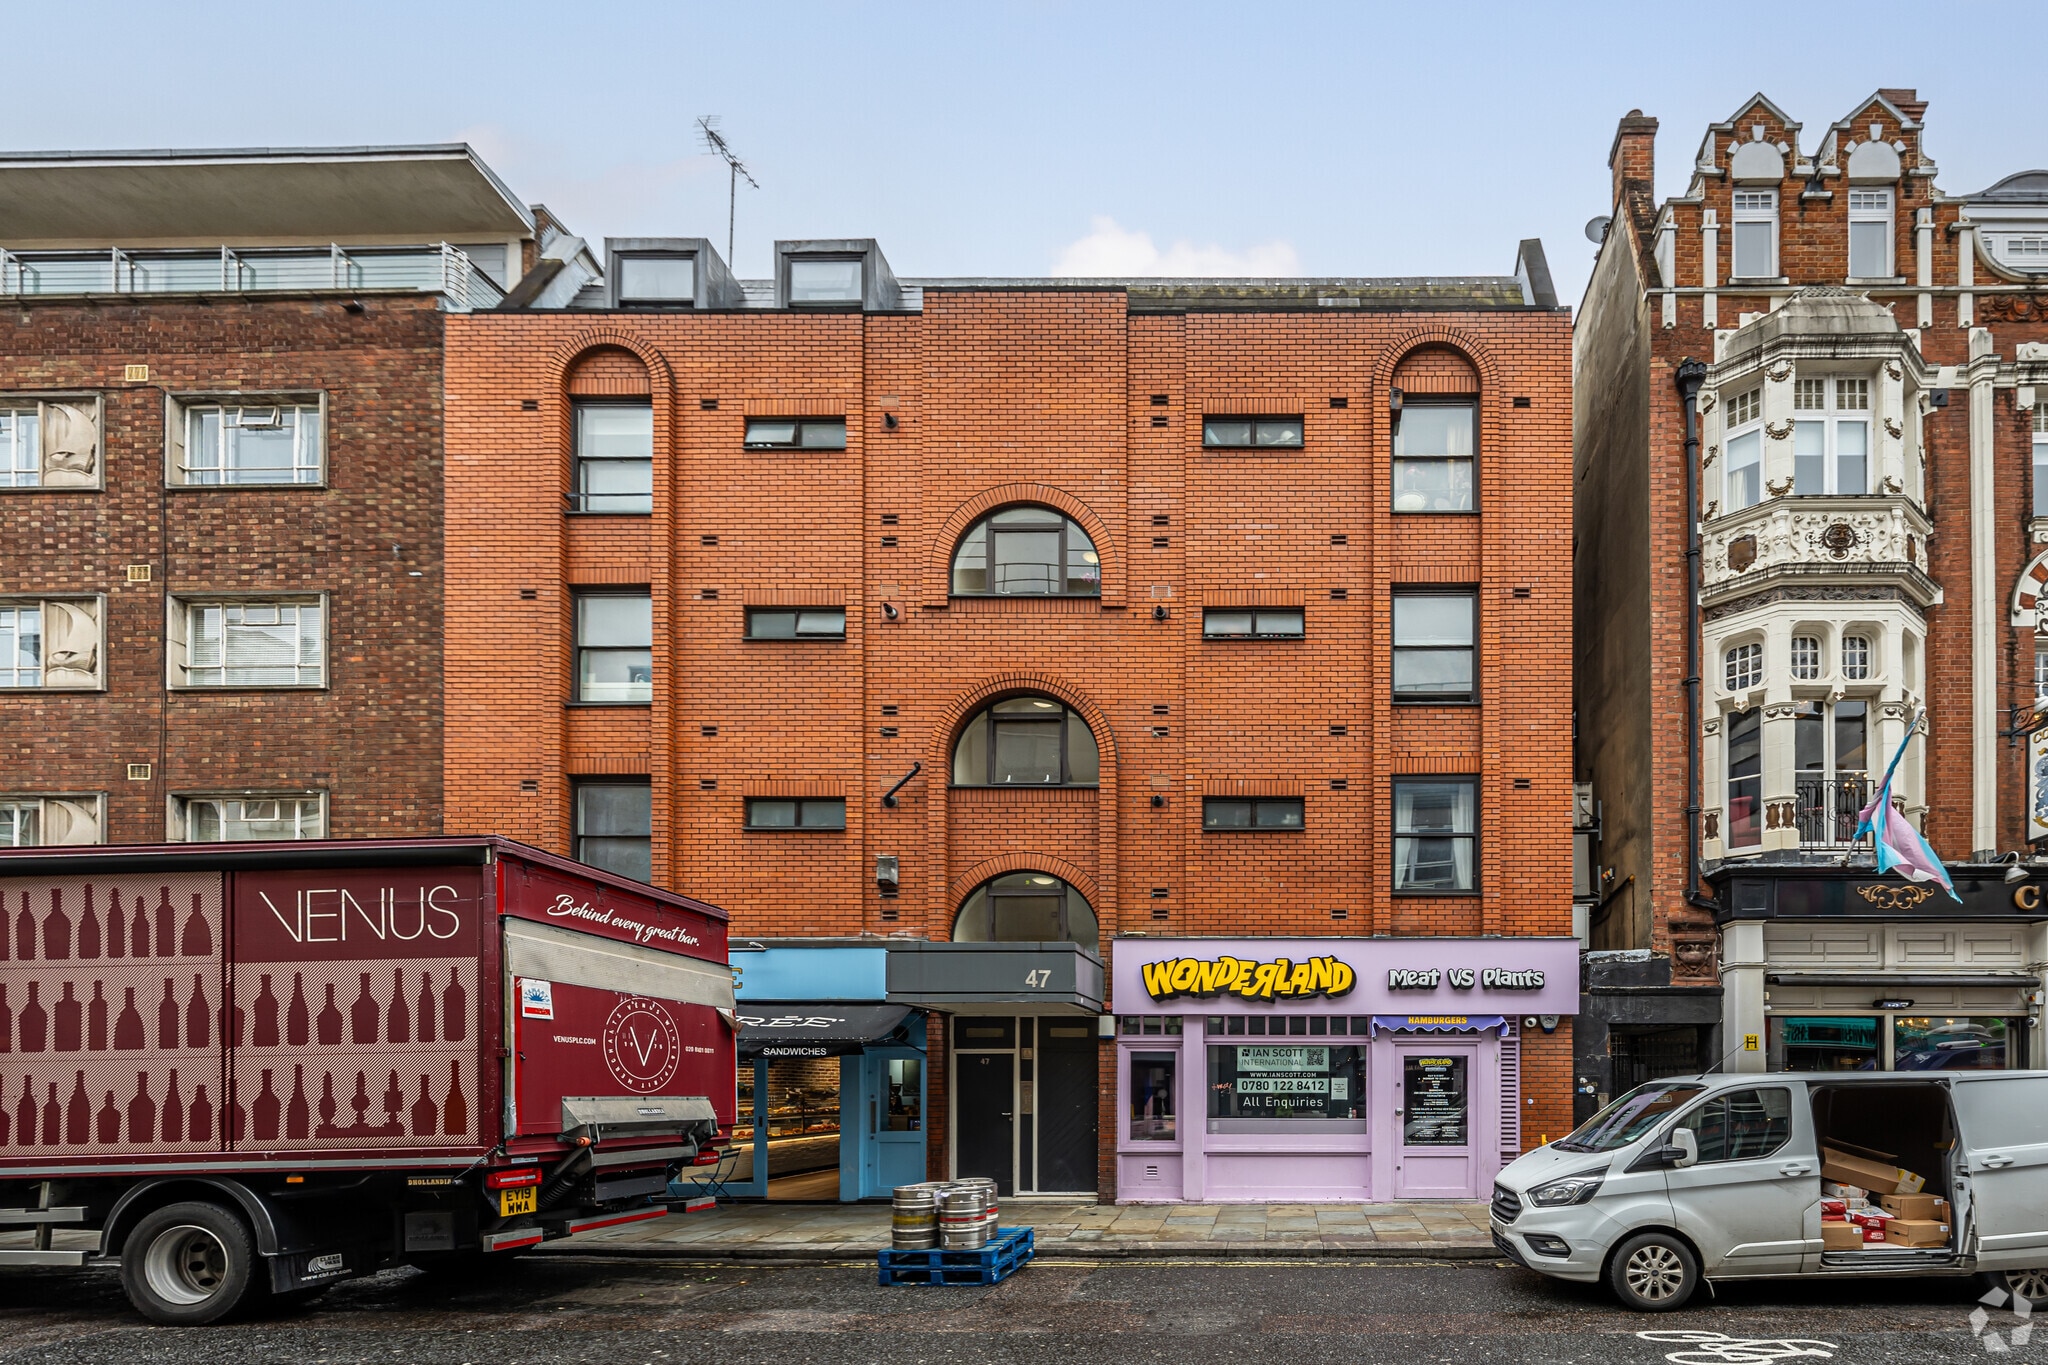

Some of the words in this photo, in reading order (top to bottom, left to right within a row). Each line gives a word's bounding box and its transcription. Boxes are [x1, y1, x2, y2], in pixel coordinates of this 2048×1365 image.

[259, 885, 460, 942] VENUS
[547, 894, 614, 924] Behind
[612, 917, 645, 941] every
[642, 926, 681, 943] great
[678, 928, 700, 946] bar.
[1025, 969, 1051, 988] 47
[1141, 956, 1356, 1003] WONDERLAND
[1388, 968, 1440, 989] Meat
[1448, 968, 1475, 989] VS
[1482, 968, 1545, 989] Plants
[1408, 1016, 1467, 1025] HAMBURGERS
[553, 1035, 597, 1045] VENUSPLC.COM
[1746, 1036, 1757, 1048] H
[763, 1047, 827, 1056] SANDWICHES
[1252, 1048, 1270, 1057] IAN
[1272, 1048, 1304, 1057] SCOTT
[1241, 1058, 1304, 1066] INTERNATIONAL
[1241, 1080, 1270, 1091] 0780
[1273, 1080, 1293, 1091] 122
[1296, 1080, 1325, 1091] 8412
[1242, 1096, 1260, 1107] All
[1265, 1096, 1324, 1109] Enquiries
[506, 1187, 531, 1202] EY19
[507, 1201, 530, 1214] WWA
